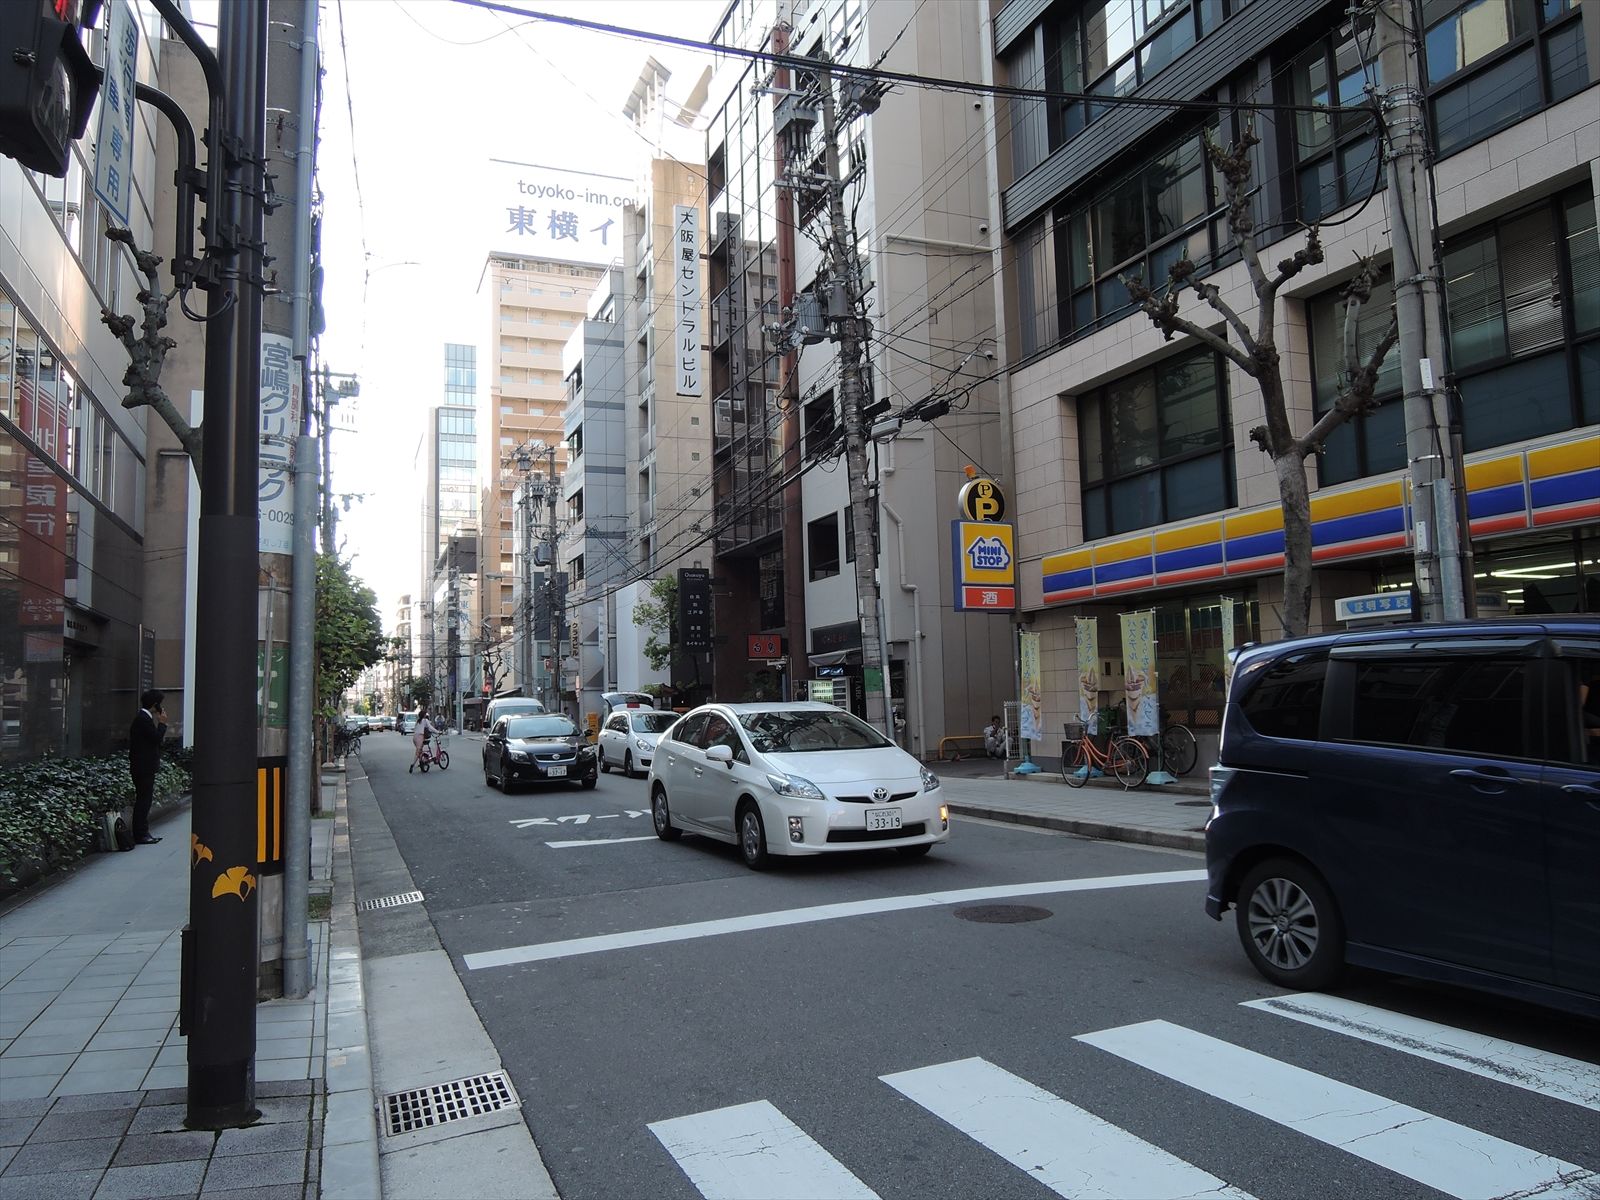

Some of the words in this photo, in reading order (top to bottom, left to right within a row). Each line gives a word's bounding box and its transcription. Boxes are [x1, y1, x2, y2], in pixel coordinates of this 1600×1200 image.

[506, 204, 615, 246] 東横イ
[680, 211, 697, 389] 大阪屋セントラルビル
[978, 545, 1002, 557] MINI
[976, 555, 1003, 566] STOP
[982, 591, 998, 605] 酒
[875, 817, 901, 829] 33-19
